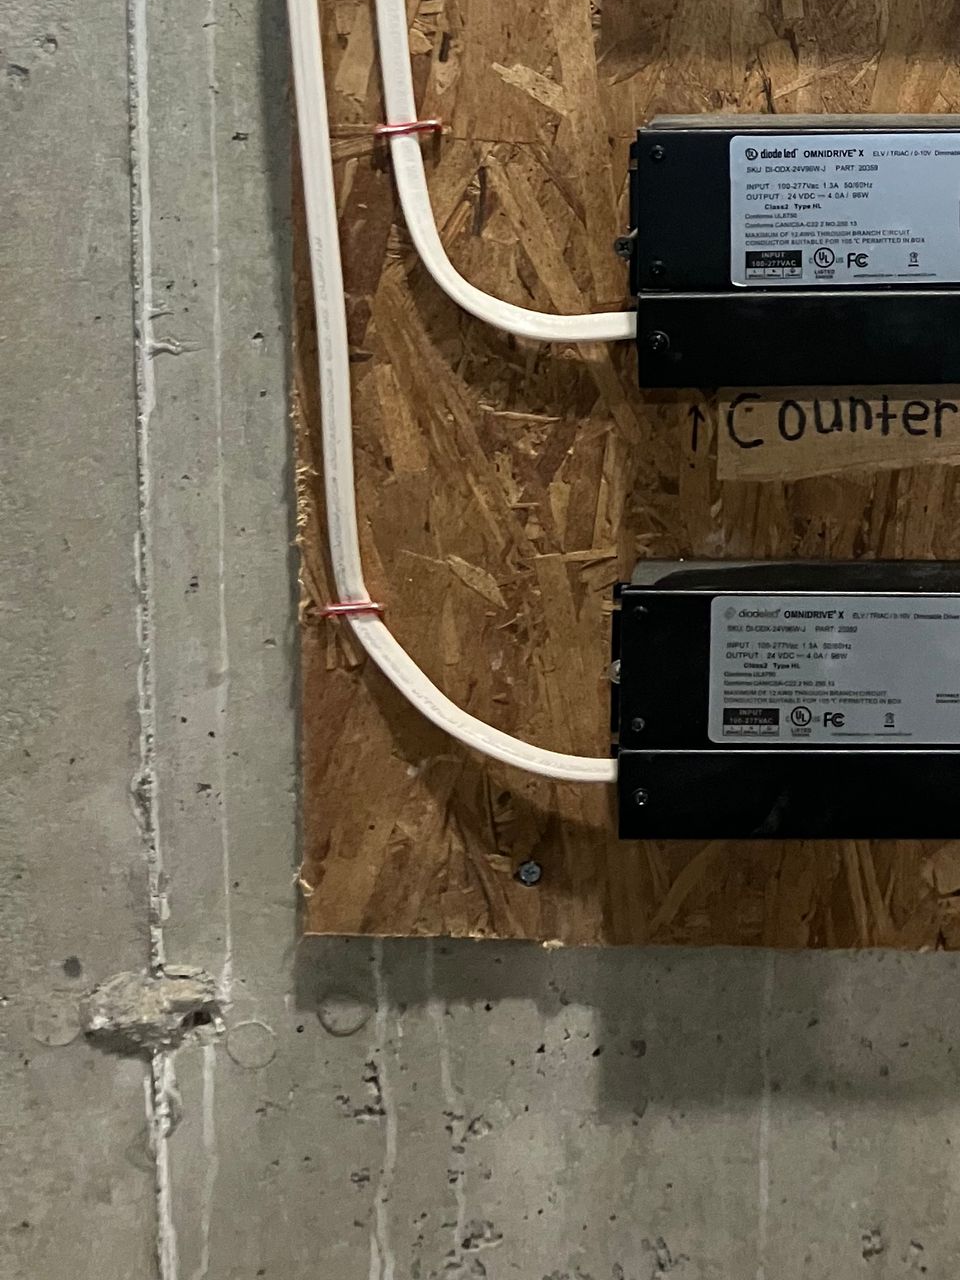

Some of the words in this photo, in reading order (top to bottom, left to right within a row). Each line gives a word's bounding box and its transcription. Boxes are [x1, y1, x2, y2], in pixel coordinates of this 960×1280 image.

[761, 150, 783, 159] diode
[783, 148, 797, 158] led
[726, 392, 958, 449] Counter
